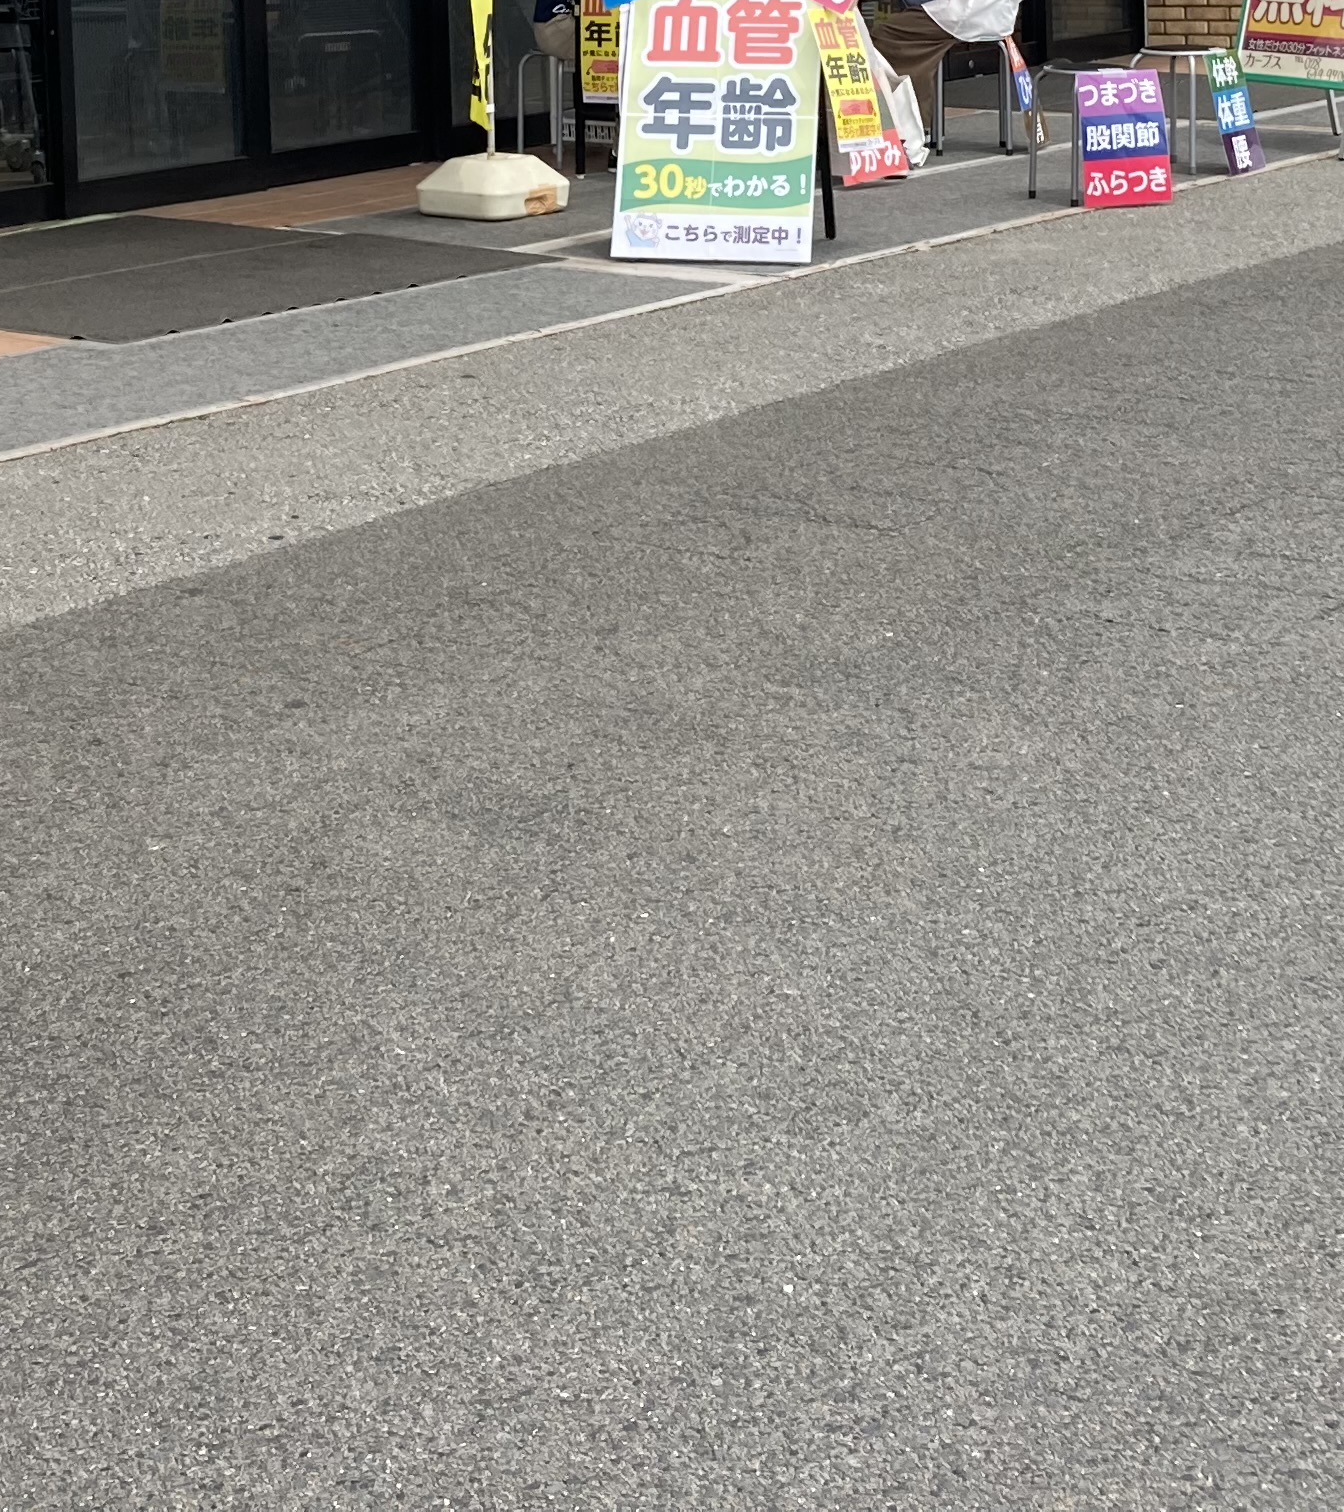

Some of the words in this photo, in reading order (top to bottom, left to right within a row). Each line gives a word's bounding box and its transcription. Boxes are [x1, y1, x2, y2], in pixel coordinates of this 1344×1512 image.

[584, 20, 620, 48] 年
[814, 16, 860, 50] 血管
[825, 51, 870, 86] 年齢
[1211, 55, 1239, 88] 体幹
[1243, 52, 1282, 70] カーブス
[1077, 77, 1157, 108] つまづき
[640, 75, 797, 153] 年齢
[1216, 91, 1251, 131] 体重
[1085, 121, 1160, 152] 股関節
[848, 139, 902, 178] ゆがみ
[632, 163, 808, 200] 30秒でわかる！
[1086, 165, 1167, 197] ふらつき
[663, 223, 804, 246] こちらで測定中！
